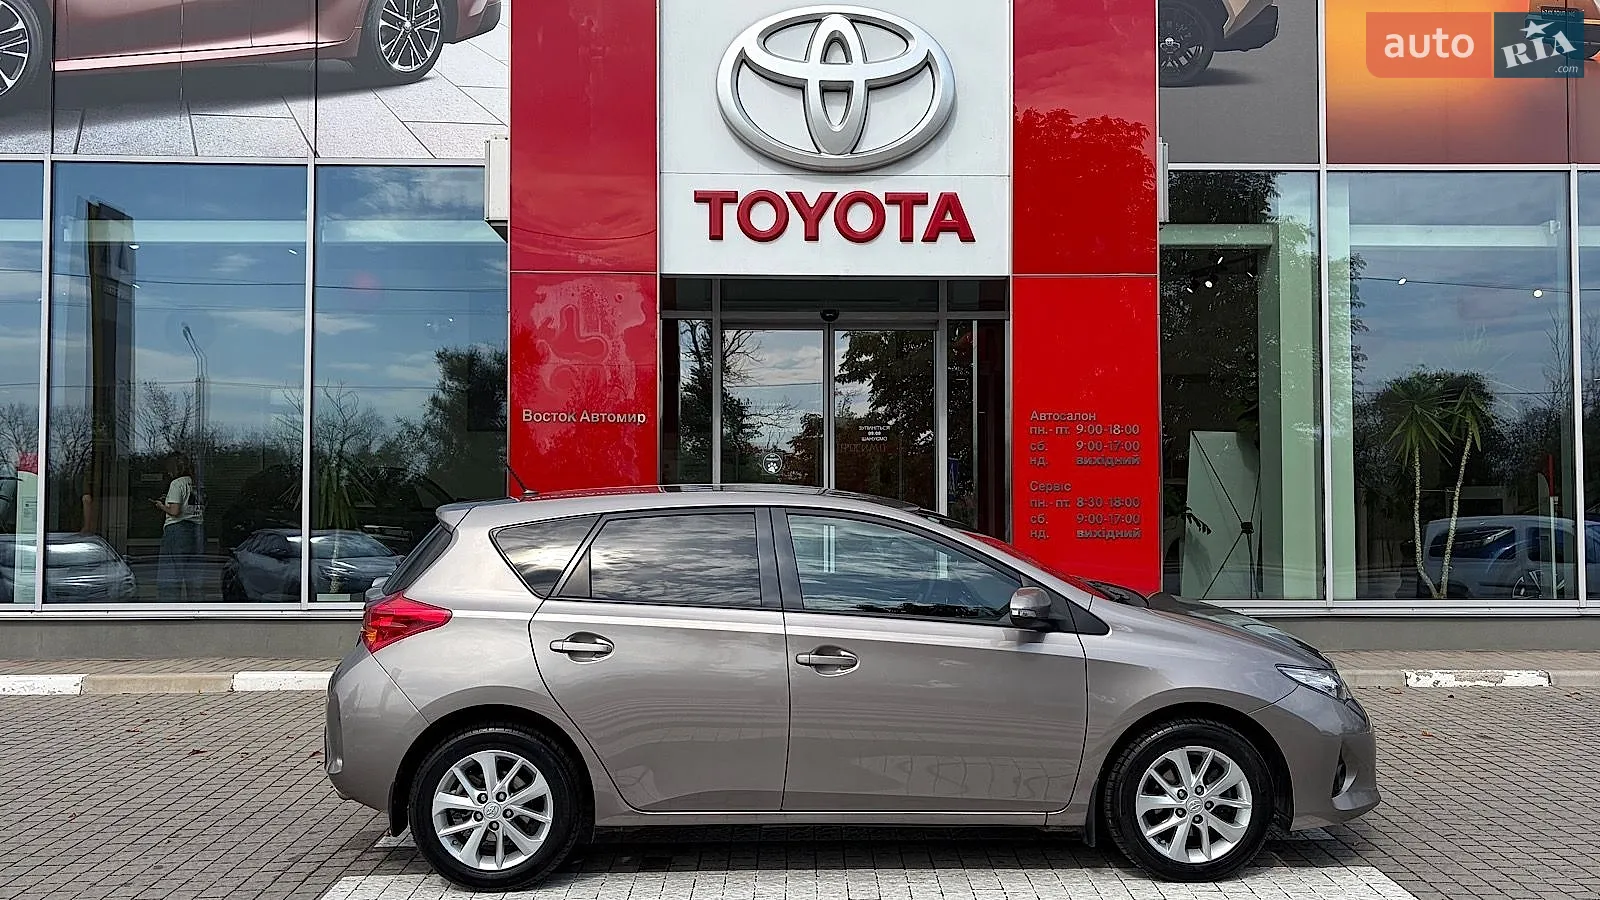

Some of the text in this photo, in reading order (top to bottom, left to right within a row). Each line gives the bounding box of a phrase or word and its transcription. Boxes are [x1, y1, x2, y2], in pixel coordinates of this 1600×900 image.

[693, 189, 976, 243] TOYOTA
[522, 409, 646, 425] Восток Автомир
[1030, 410, 1096, 421] Автосалон
[1075, 424, 1140, 435] 9:00-18:00
[1030, 440, 1140, 451] сб. 9:00-17:00
[1029, 454, 1141, 466] нд. вихідний
[1029, 480, 1072, 493] Сервіс
[1030, 513, 1140, 524] сб. 9:00-17:00
[1030, 527, 1141, 540] нд. вихідний
